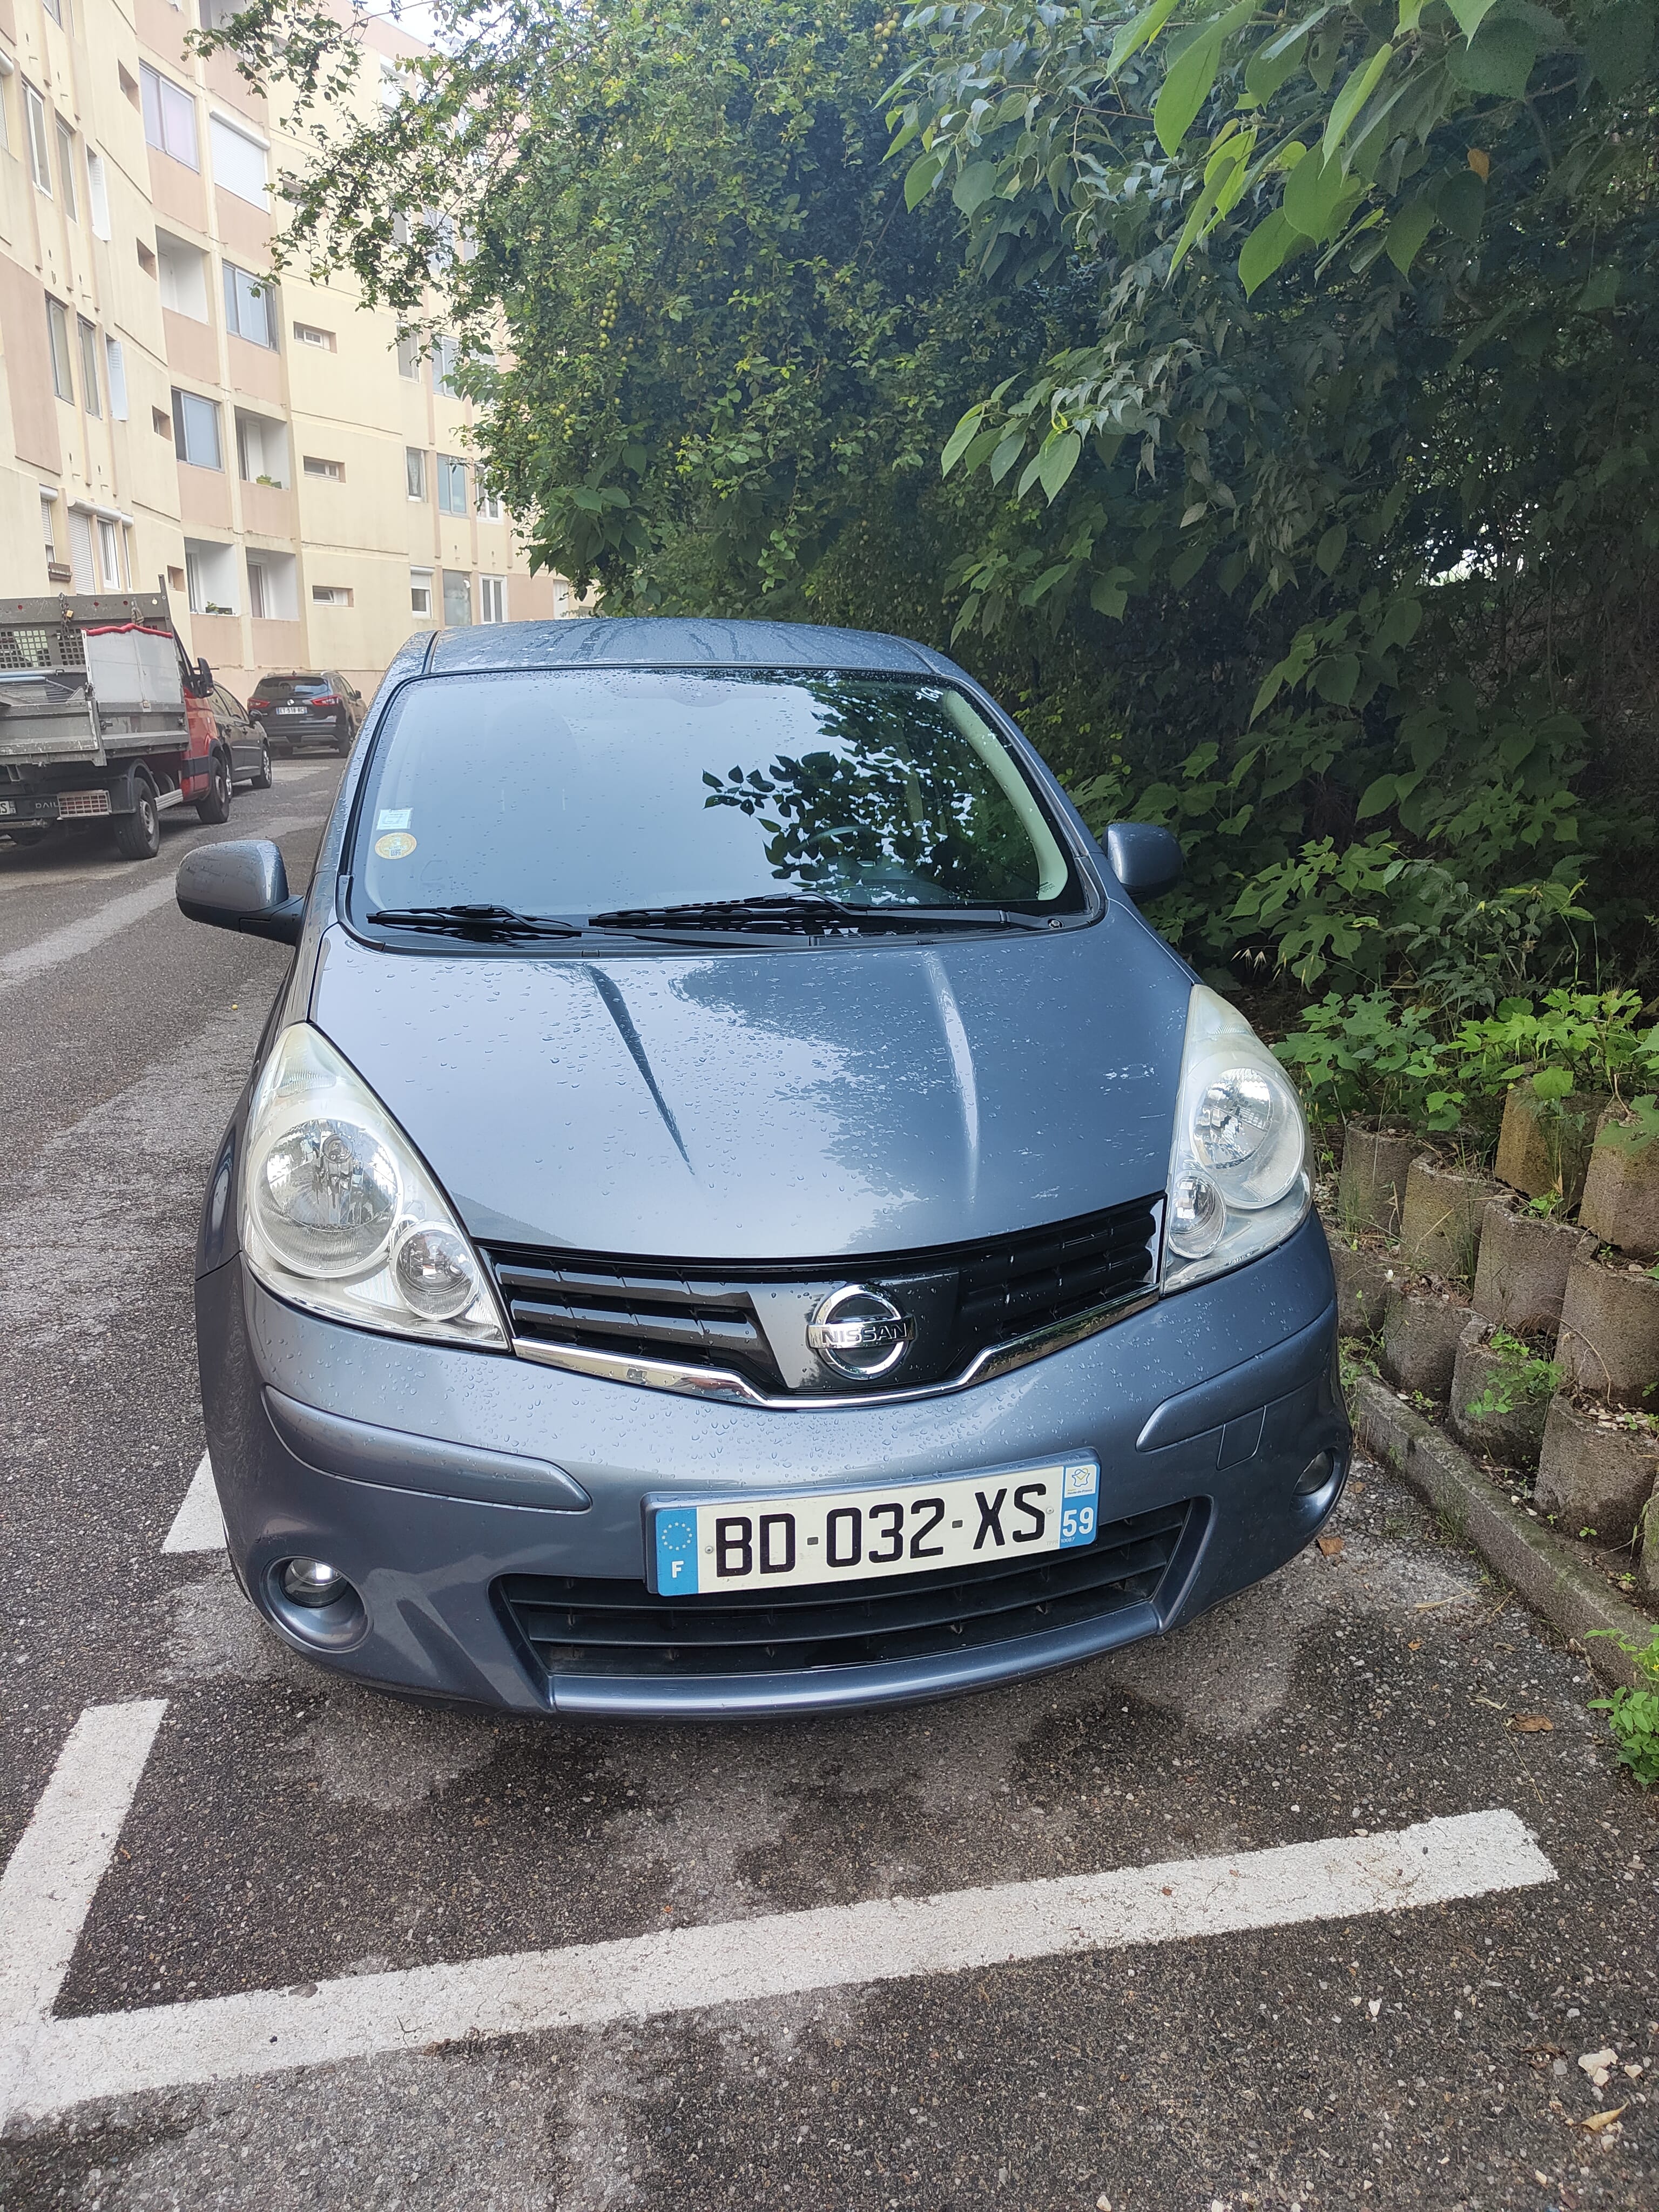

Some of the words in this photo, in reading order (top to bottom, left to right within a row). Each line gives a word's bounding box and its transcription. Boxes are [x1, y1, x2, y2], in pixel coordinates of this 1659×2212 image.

[820, 1323, 907, 1345] NISSAN
[716, 1483, 1047, 1577] BD-032-XS
[1062, 1507, 1094, 1537] 59
[671, 1560, 684, 1578] F
